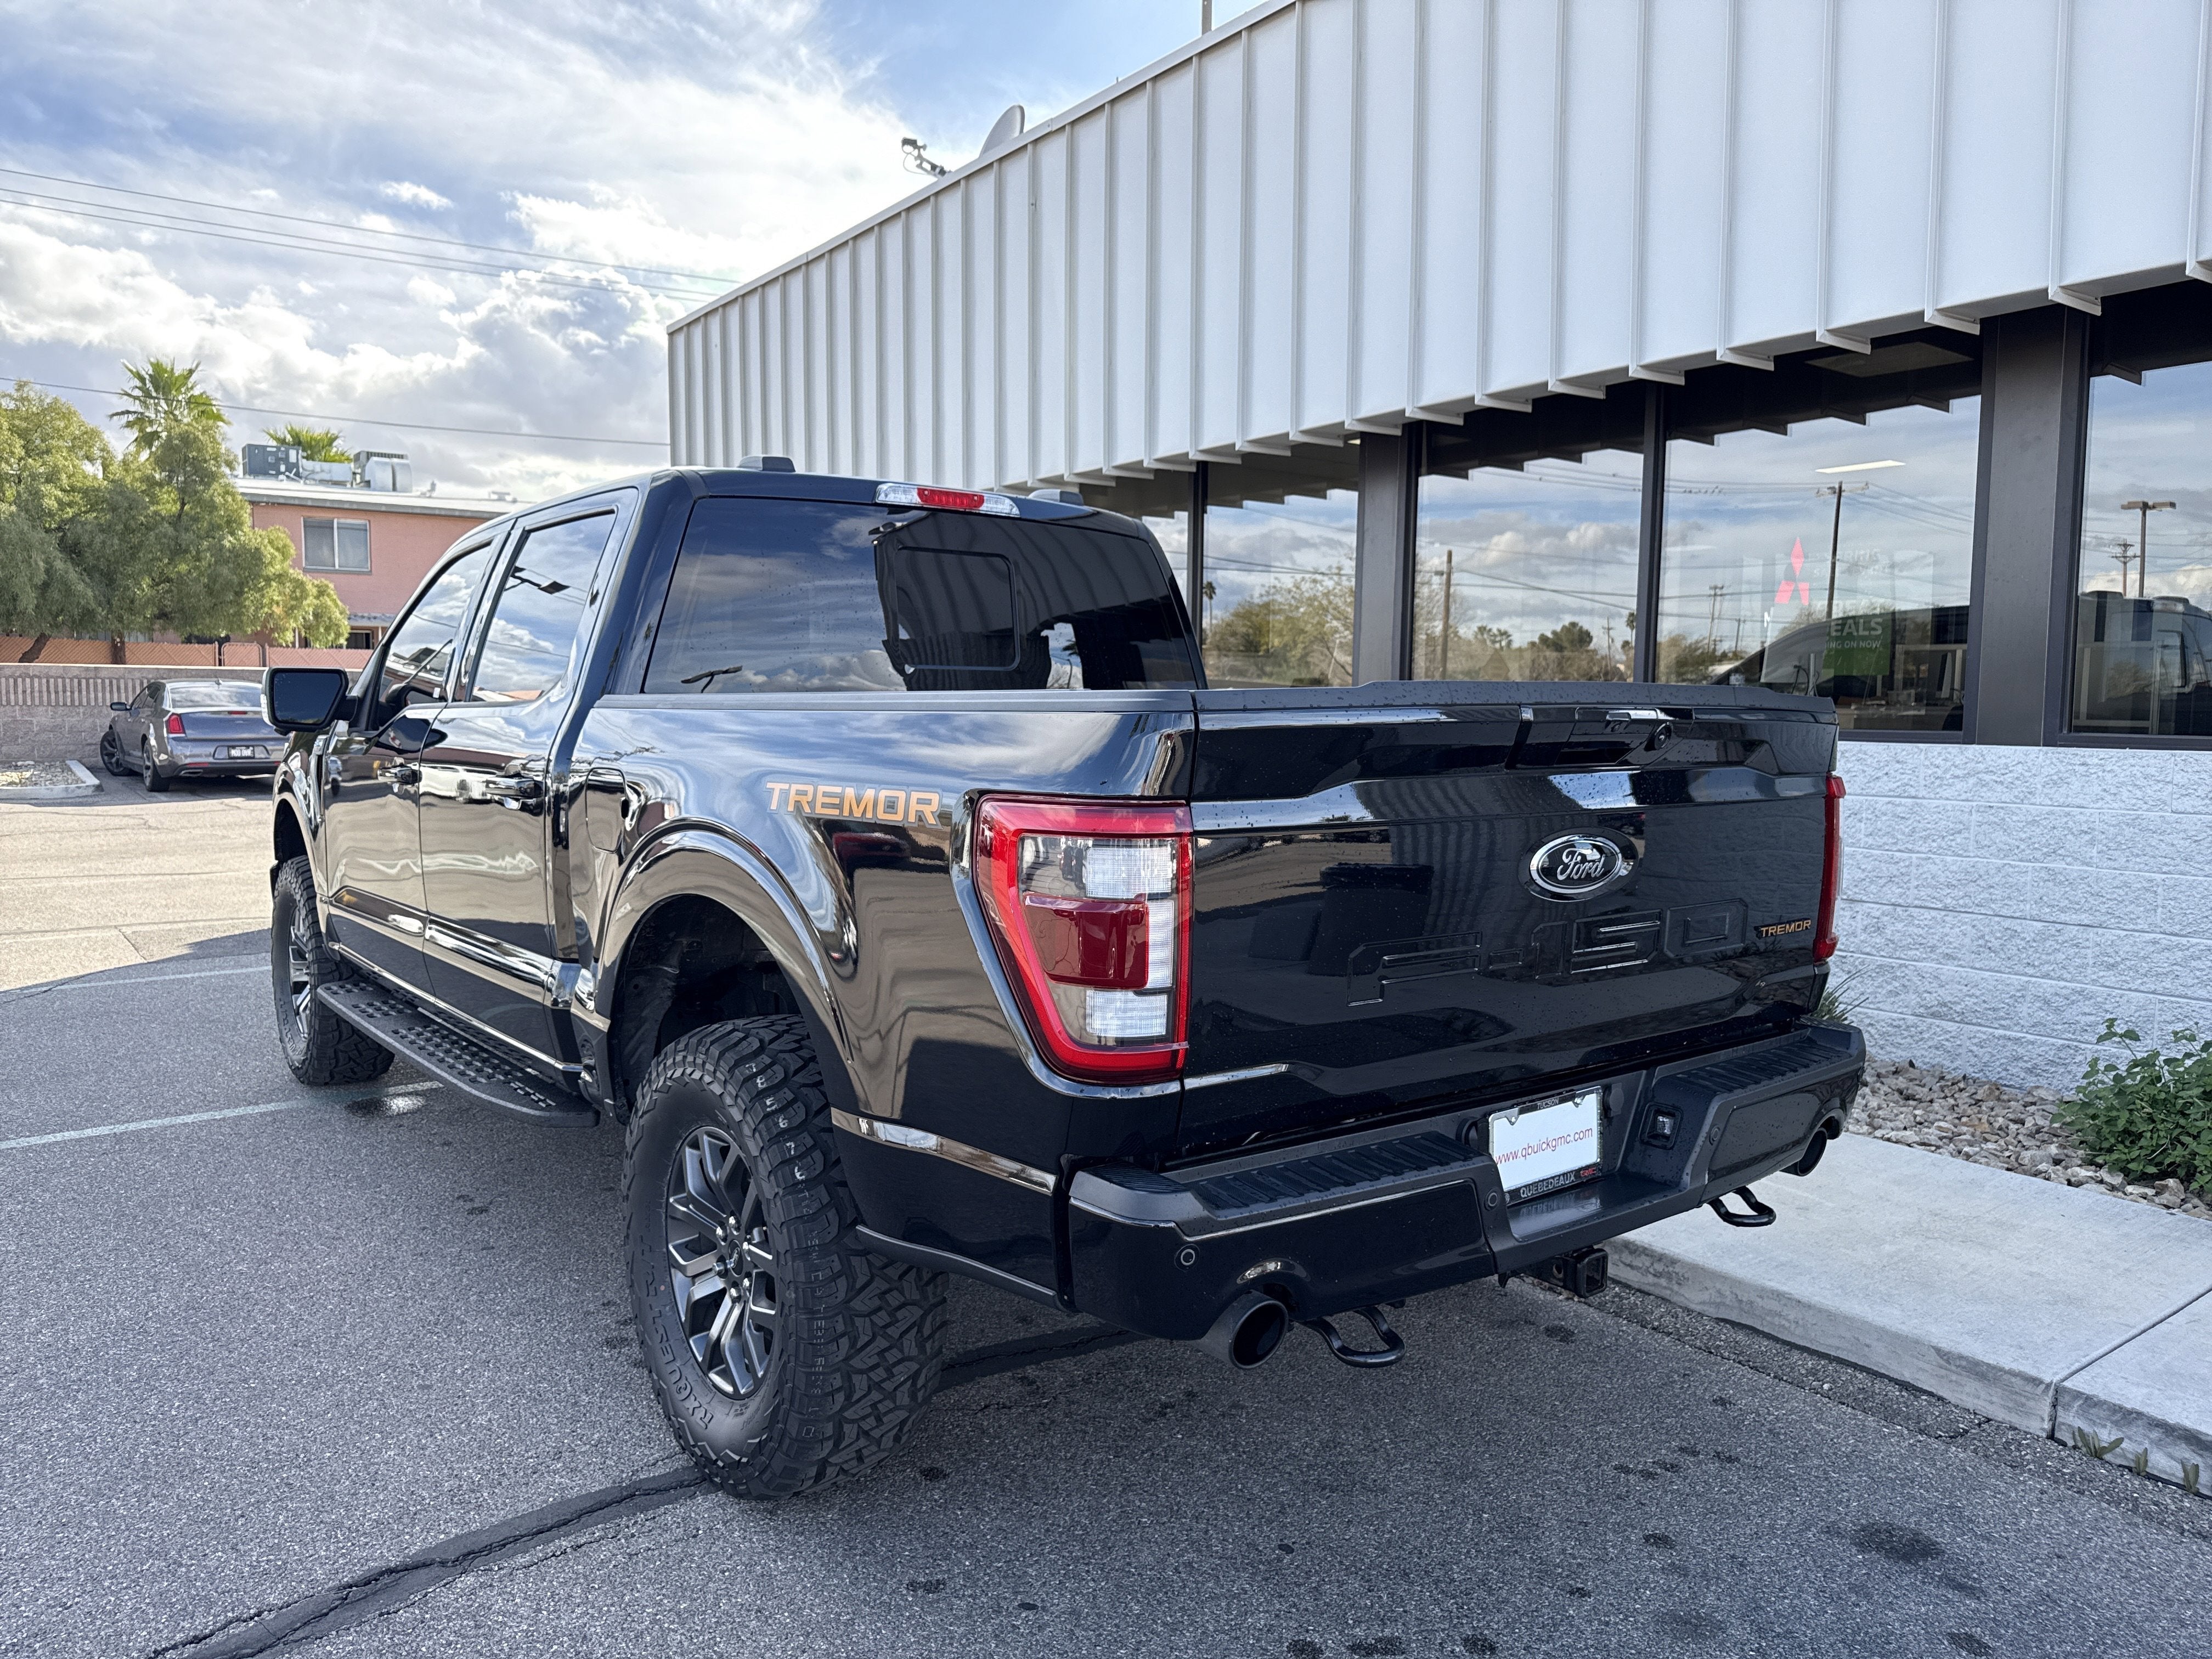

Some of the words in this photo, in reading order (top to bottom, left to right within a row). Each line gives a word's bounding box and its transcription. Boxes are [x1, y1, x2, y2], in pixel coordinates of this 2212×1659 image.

[1830, 618, 1883, 637] EALS
[1844, 640, 1857, 648] ON
[1859, 639, 1881, 649] NOW
[765, 781, 941, 826] TREMOR
[1556, 847, 1606, 881] Ford
[1759, 919, 1812, 938] TREMOR
[1346, 898, 1749, 1007] F-150
[1537, 1097, 1559, 1110] TUCSON
[1495, 1127, 1593, 1166] www.qbuickgmc.com
[1519, 1171, 1577, 1198] QUEBEDEAUX
[1579, 1167, 1598, 1178] GMC
